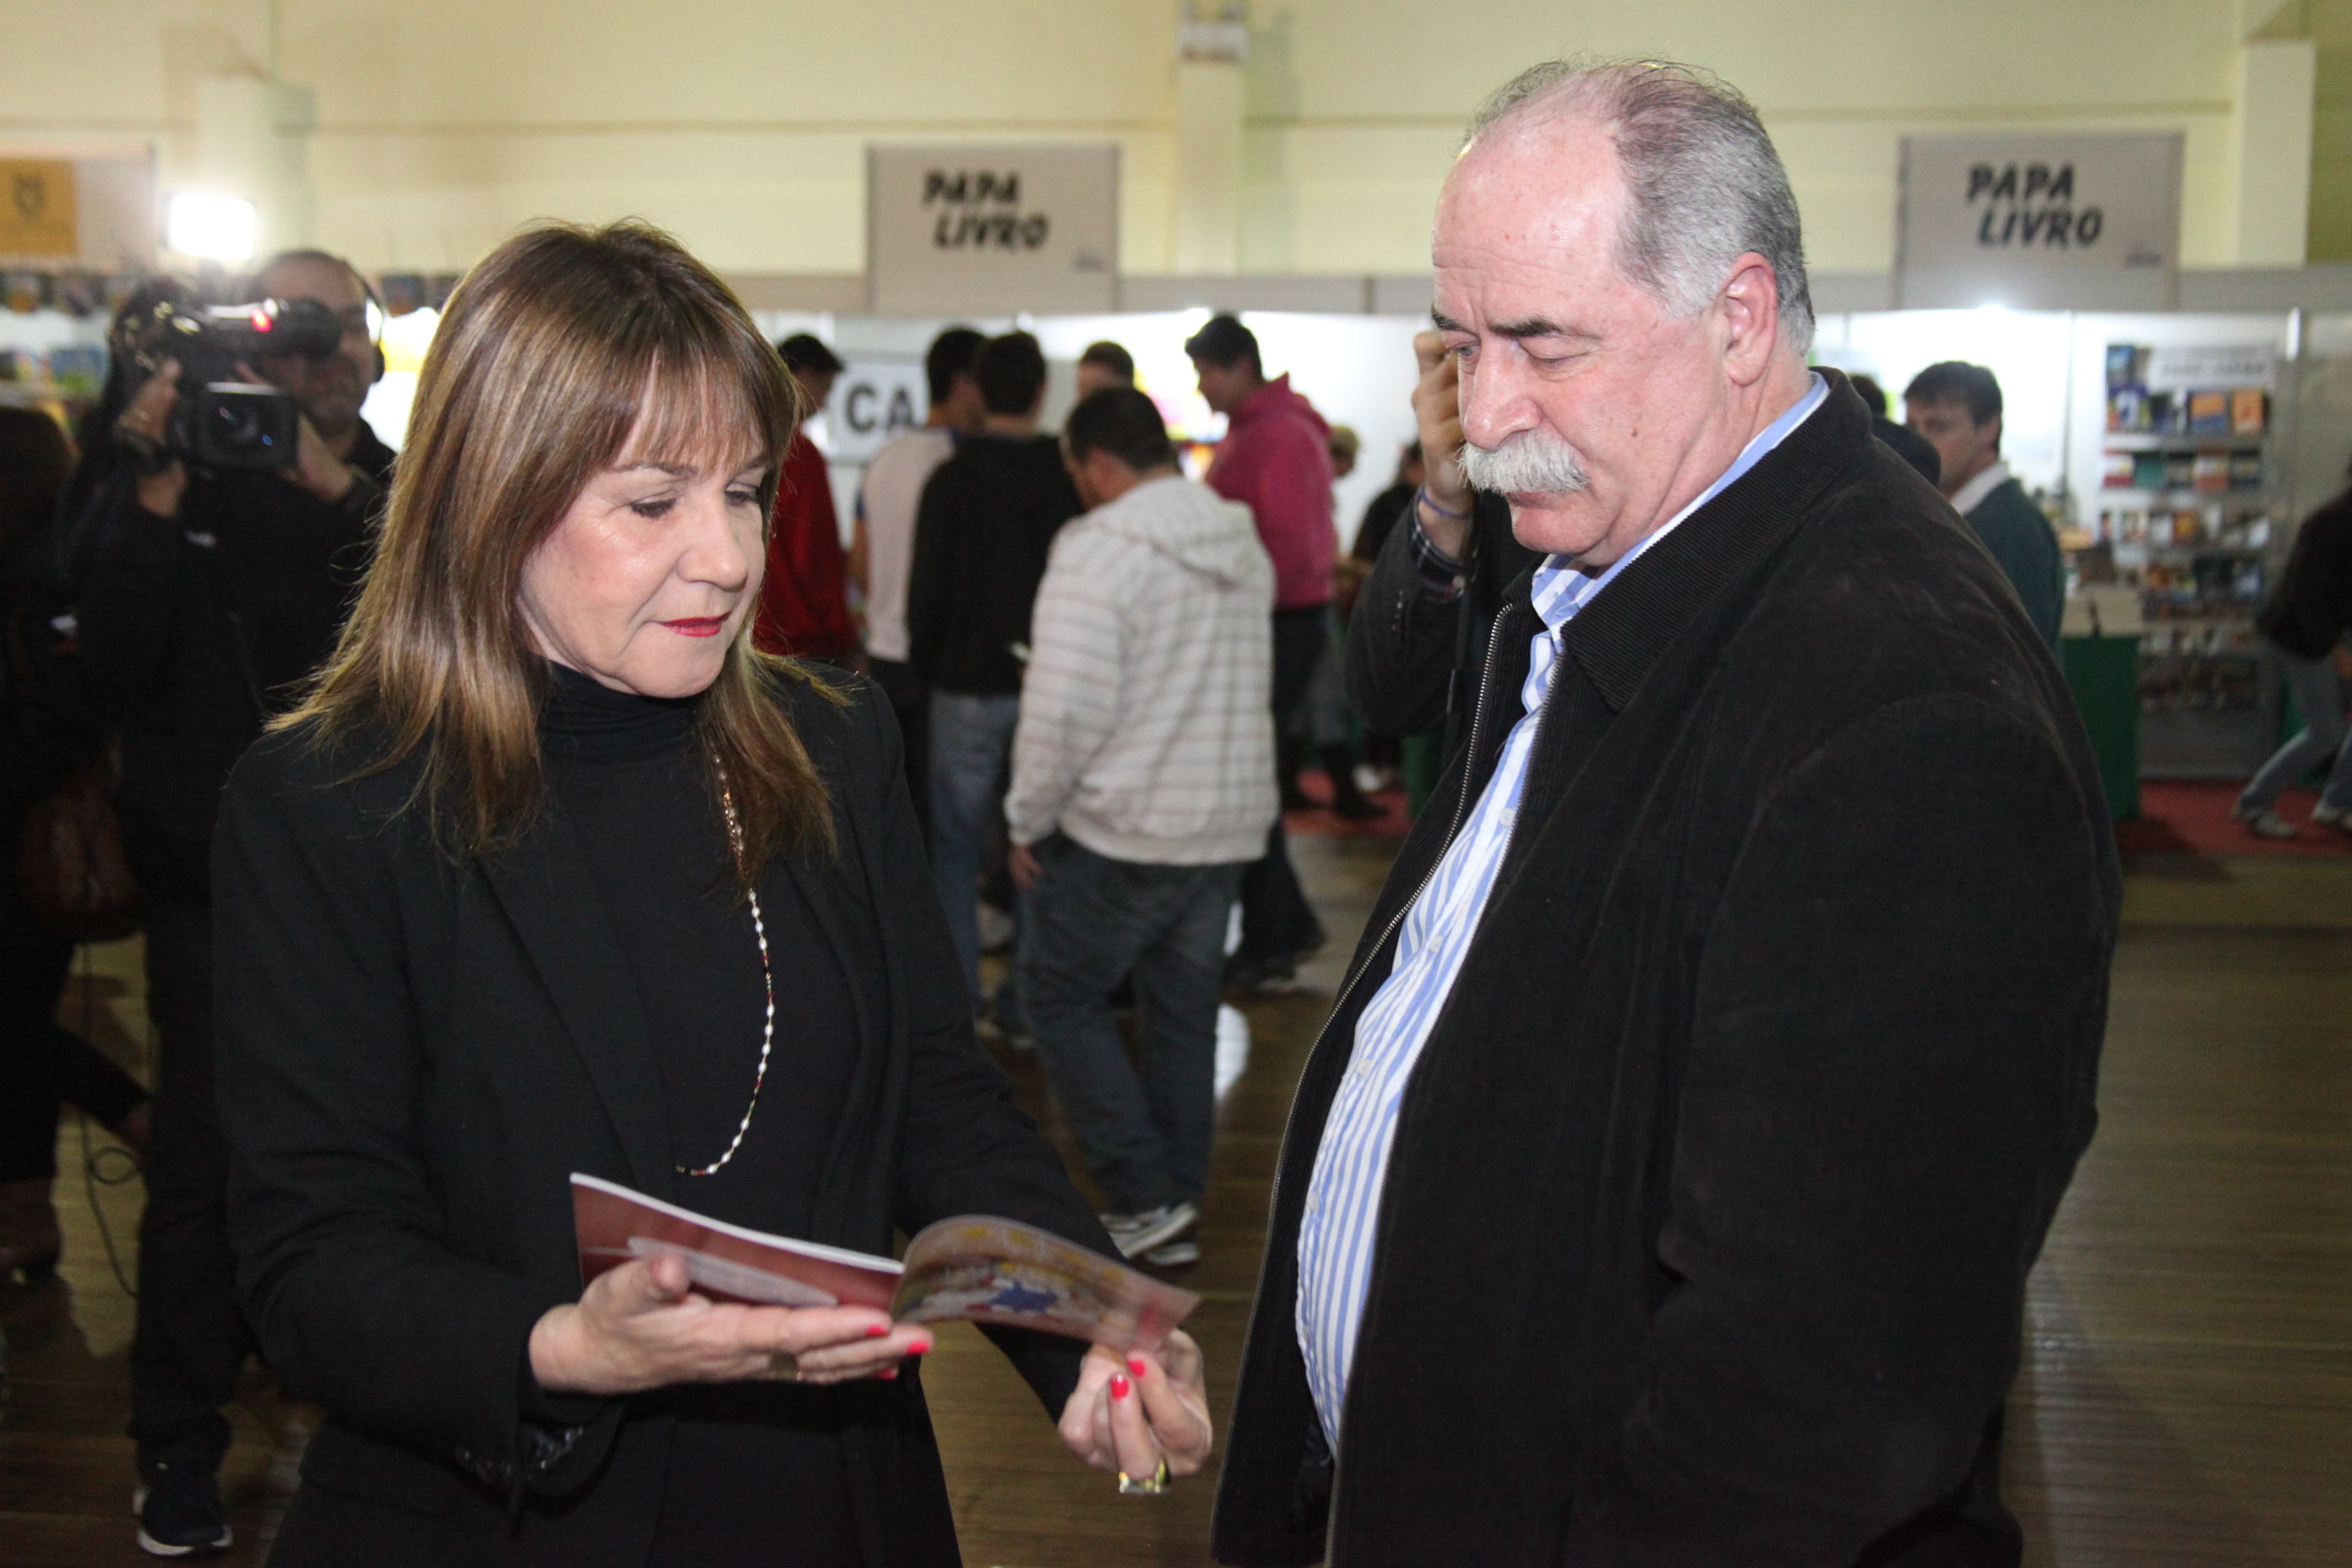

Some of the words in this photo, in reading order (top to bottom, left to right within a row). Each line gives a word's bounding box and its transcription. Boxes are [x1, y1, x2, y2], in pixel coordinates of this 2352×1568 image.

[923, 171, 1020, 205] PAPA
[1967, 161, 2075, 203] PAPA
[935, 213, 1049, 249] LIVRO
[1979, 208, 2103, 247] LIVRO
